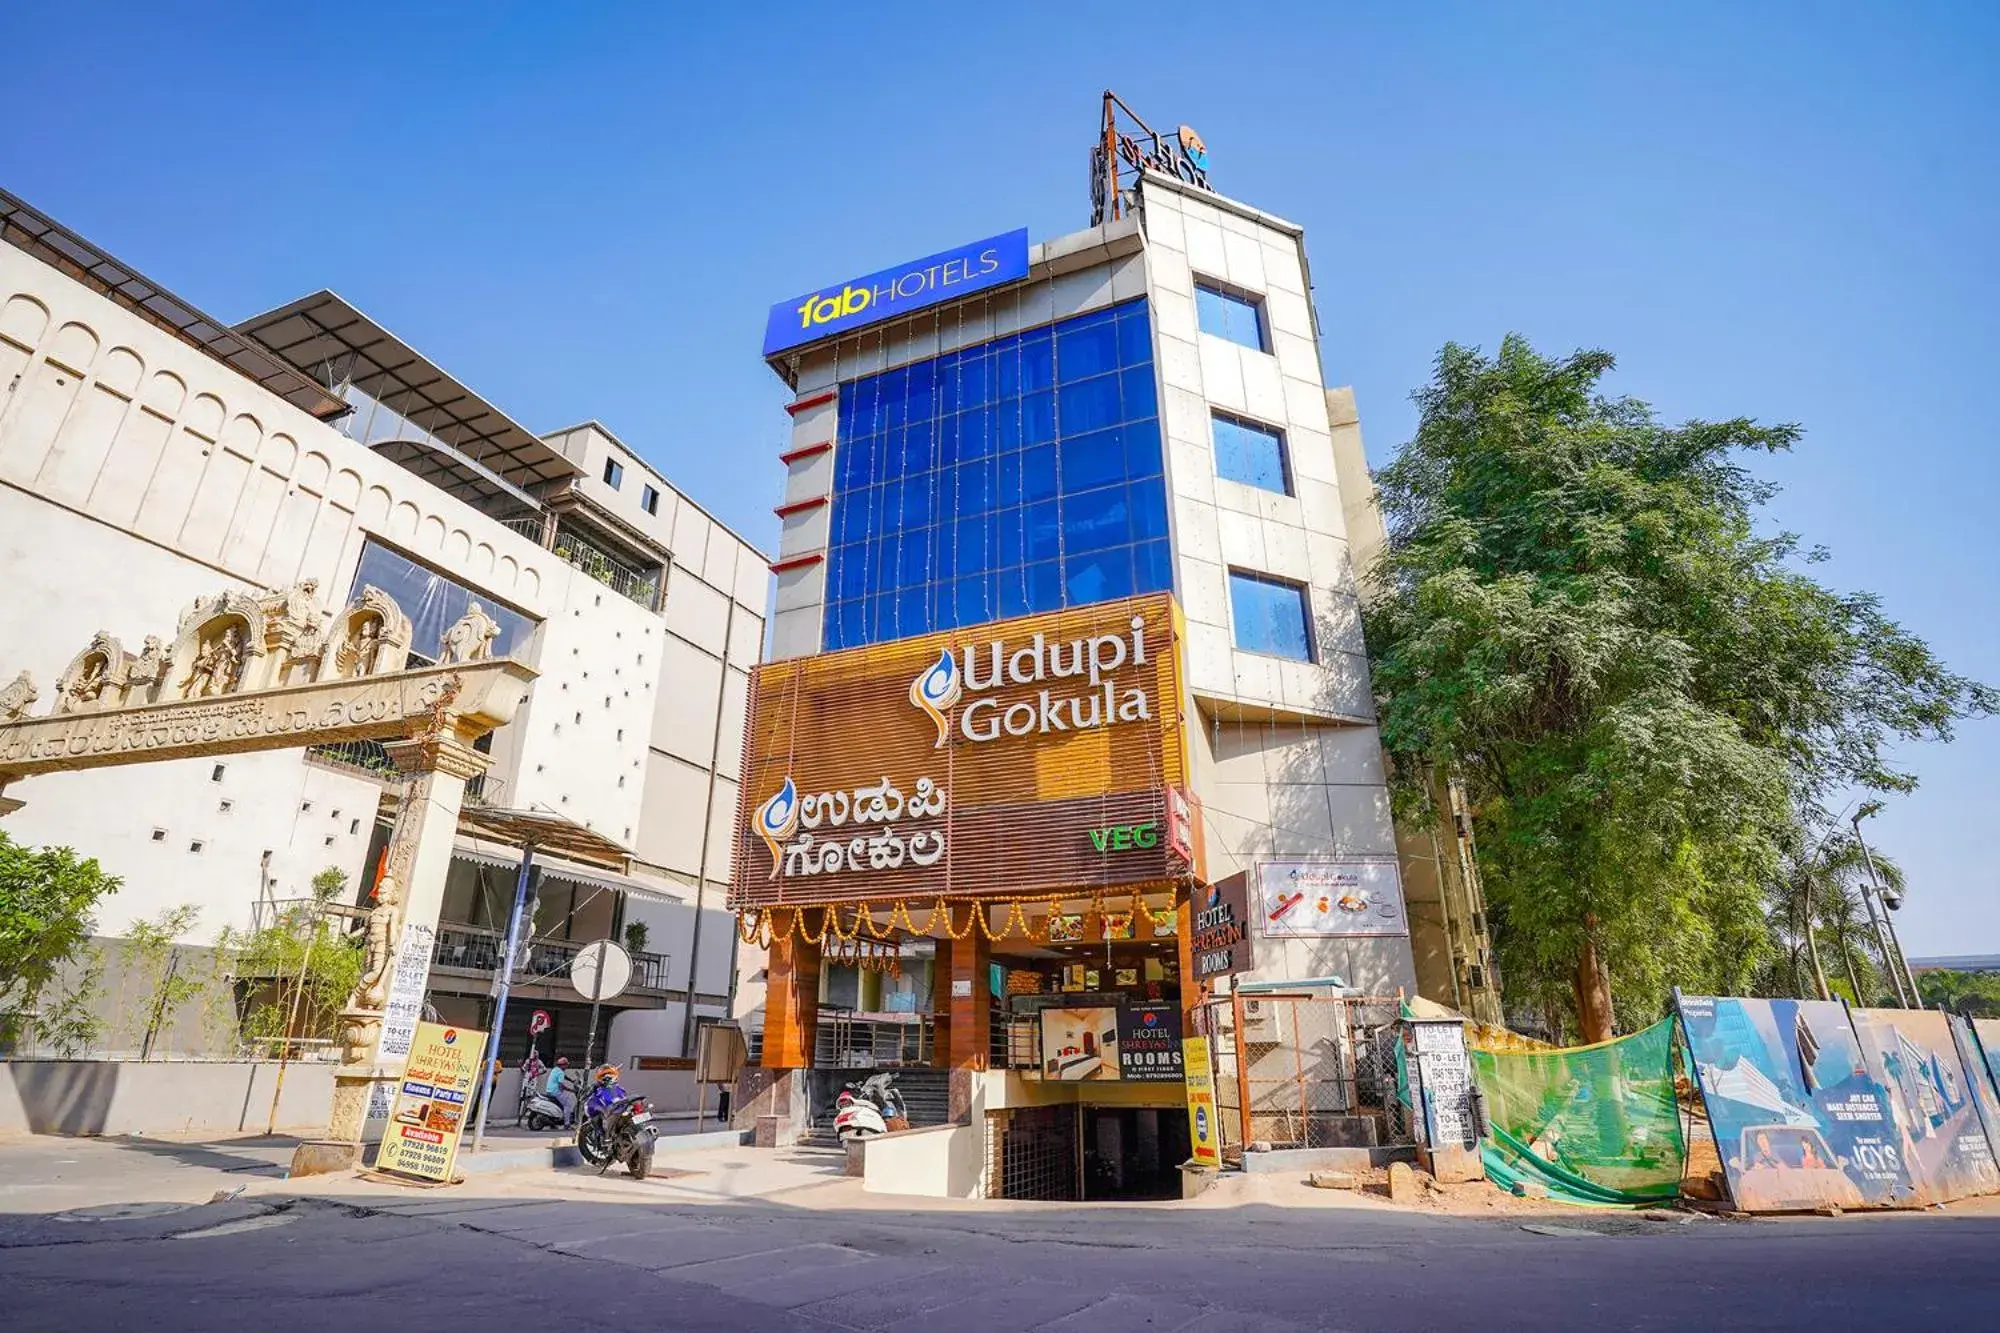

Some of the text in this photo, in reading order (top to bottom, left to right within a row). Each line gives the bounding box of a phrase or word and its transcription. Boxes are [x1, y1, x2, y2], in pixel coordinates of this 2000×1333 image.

[798, 249, 998, 328] fabHOTELS
[962, 617, 1147, 690] Udupi
[960, 679, 1153, 743] Gokula
[799, 775, 946, 829] ಉಡುಪಿ
[783, 826, 946, 877] ಗೋಕುಲ
[1089, 822, 1158, 853] VEG
[1197, 903, 1230, 931] HOTEL
[1201, 950, 1229, 975] ROOMS
[1132, 1028, 1170, 1040] HOTEL
[428, 1044, 463, 1060] HOTEL
[1122, 1051, 1182, 1066] ROOMS
[1850, 1144, 1900, 1171] JOYS
